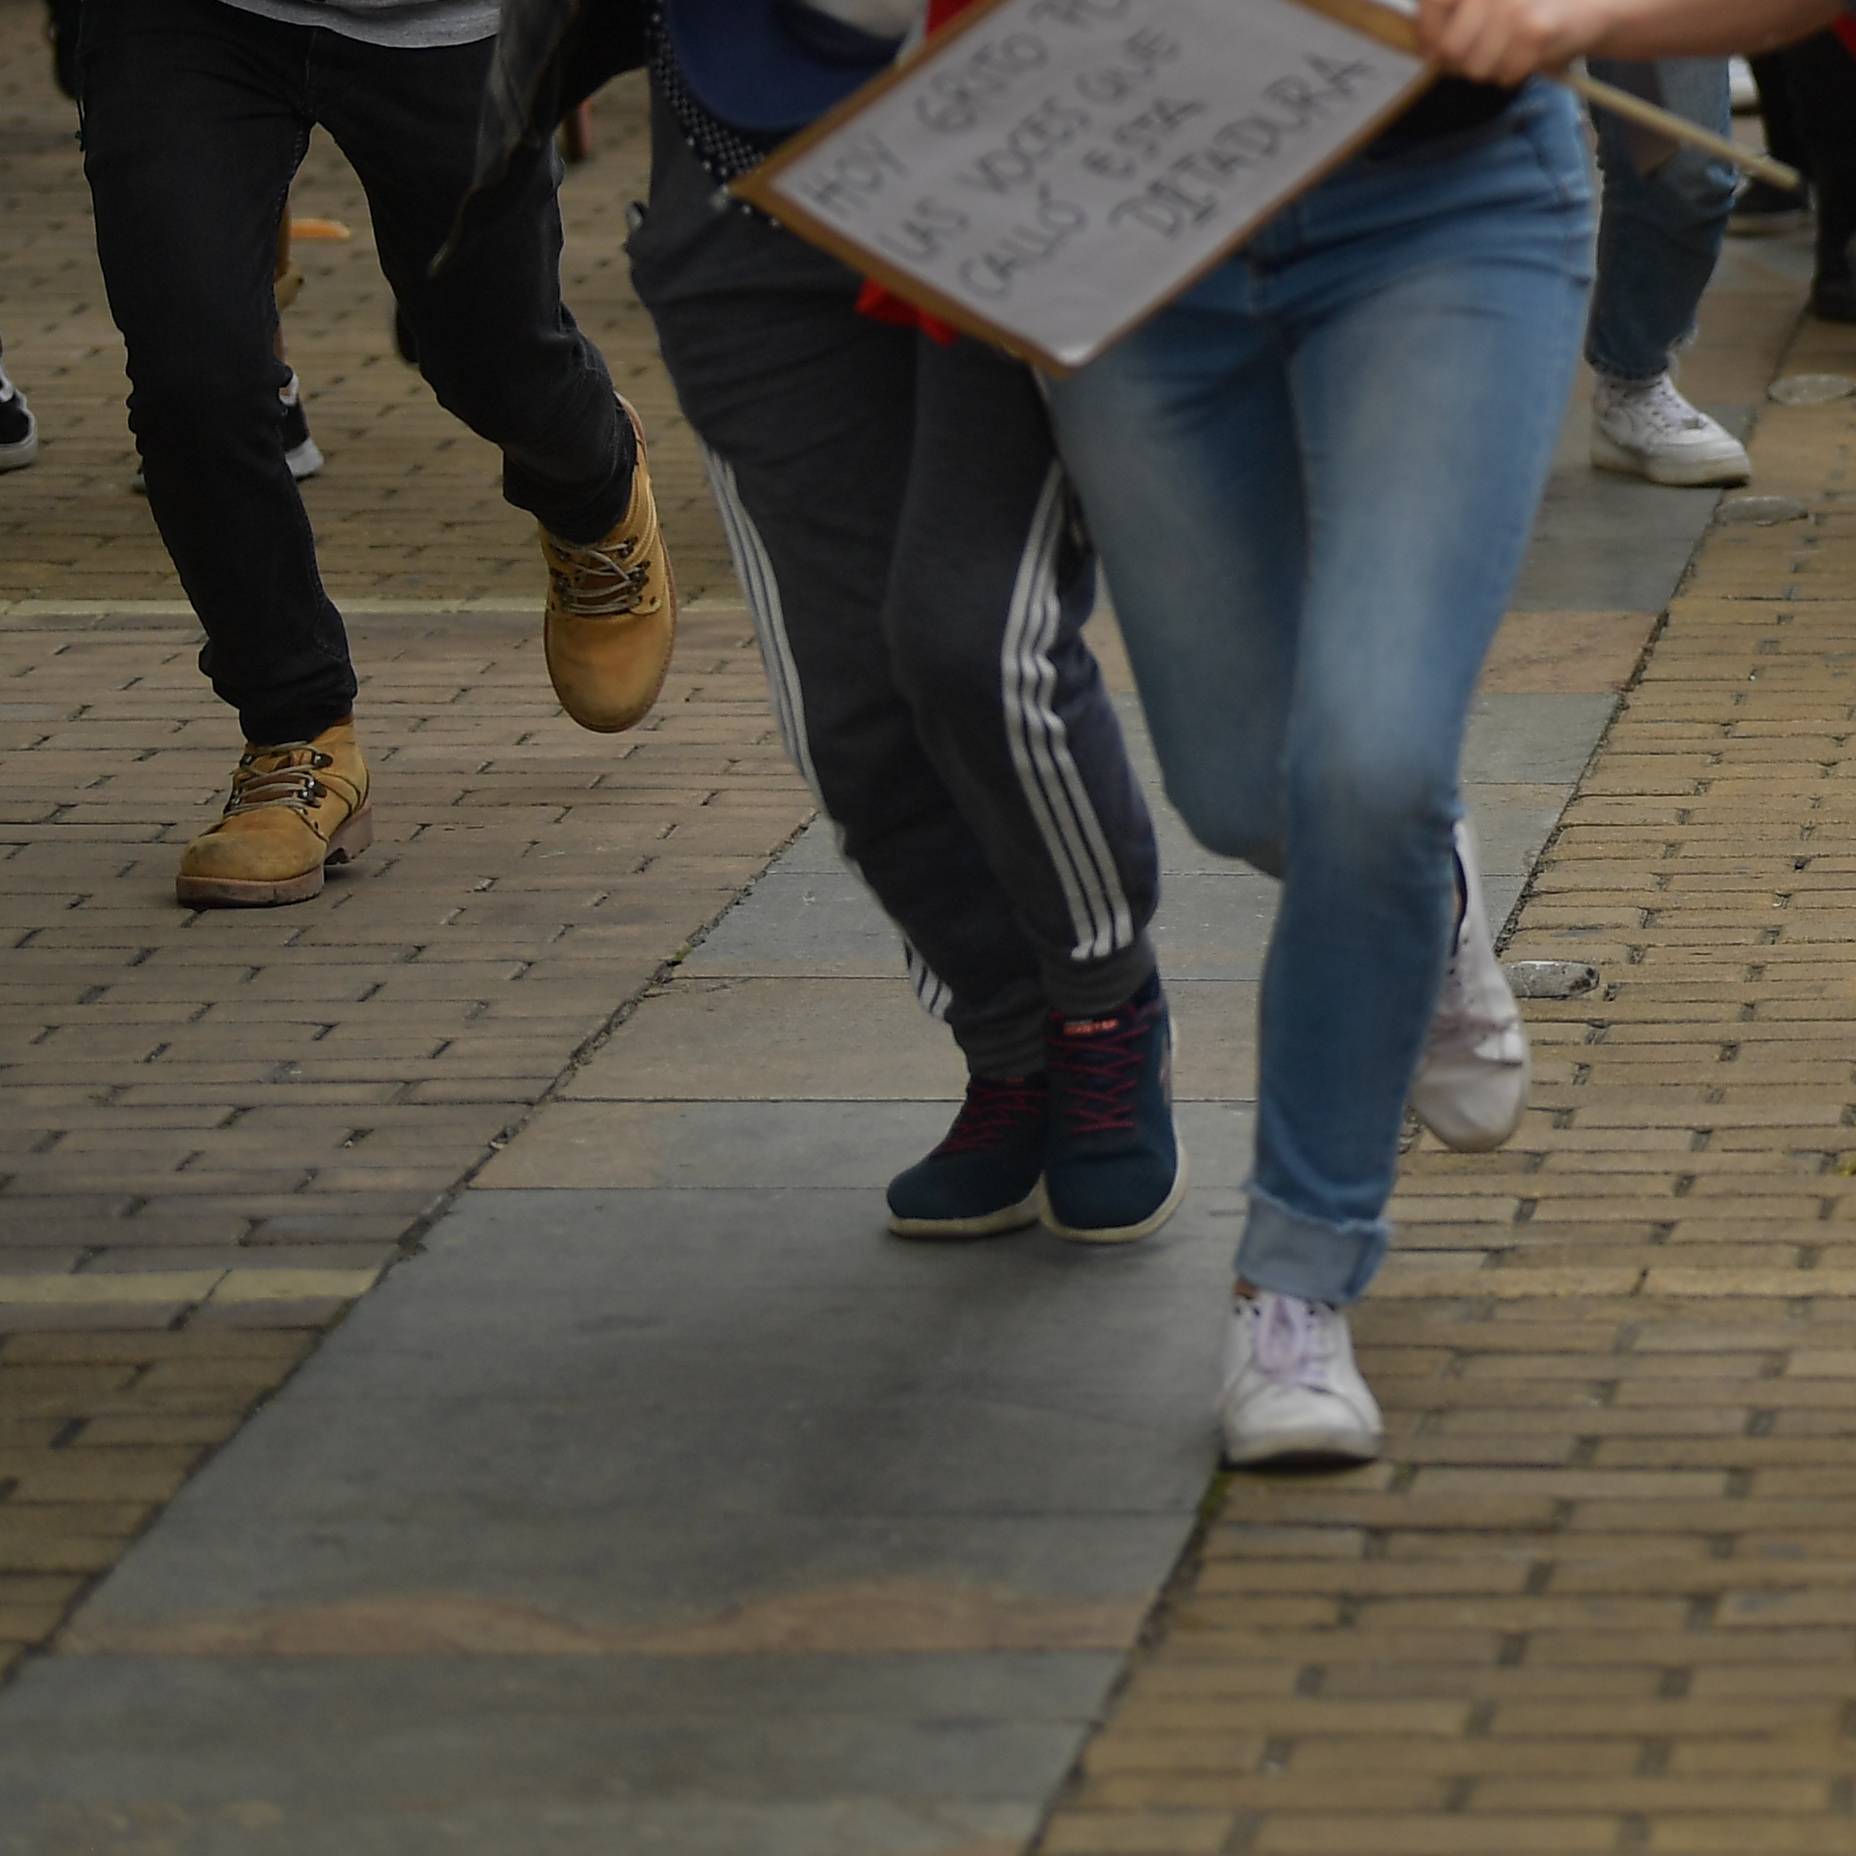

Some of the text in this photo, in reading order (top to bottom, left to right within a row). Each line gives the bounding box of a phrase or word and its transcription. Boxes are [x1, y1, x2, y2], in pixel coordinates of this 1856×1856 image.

[803, 132, 906, 218] HOY
[917, 33, 1046, 134] GRITO
[872, 30, 1179, 263] LAS VOCES QUE
